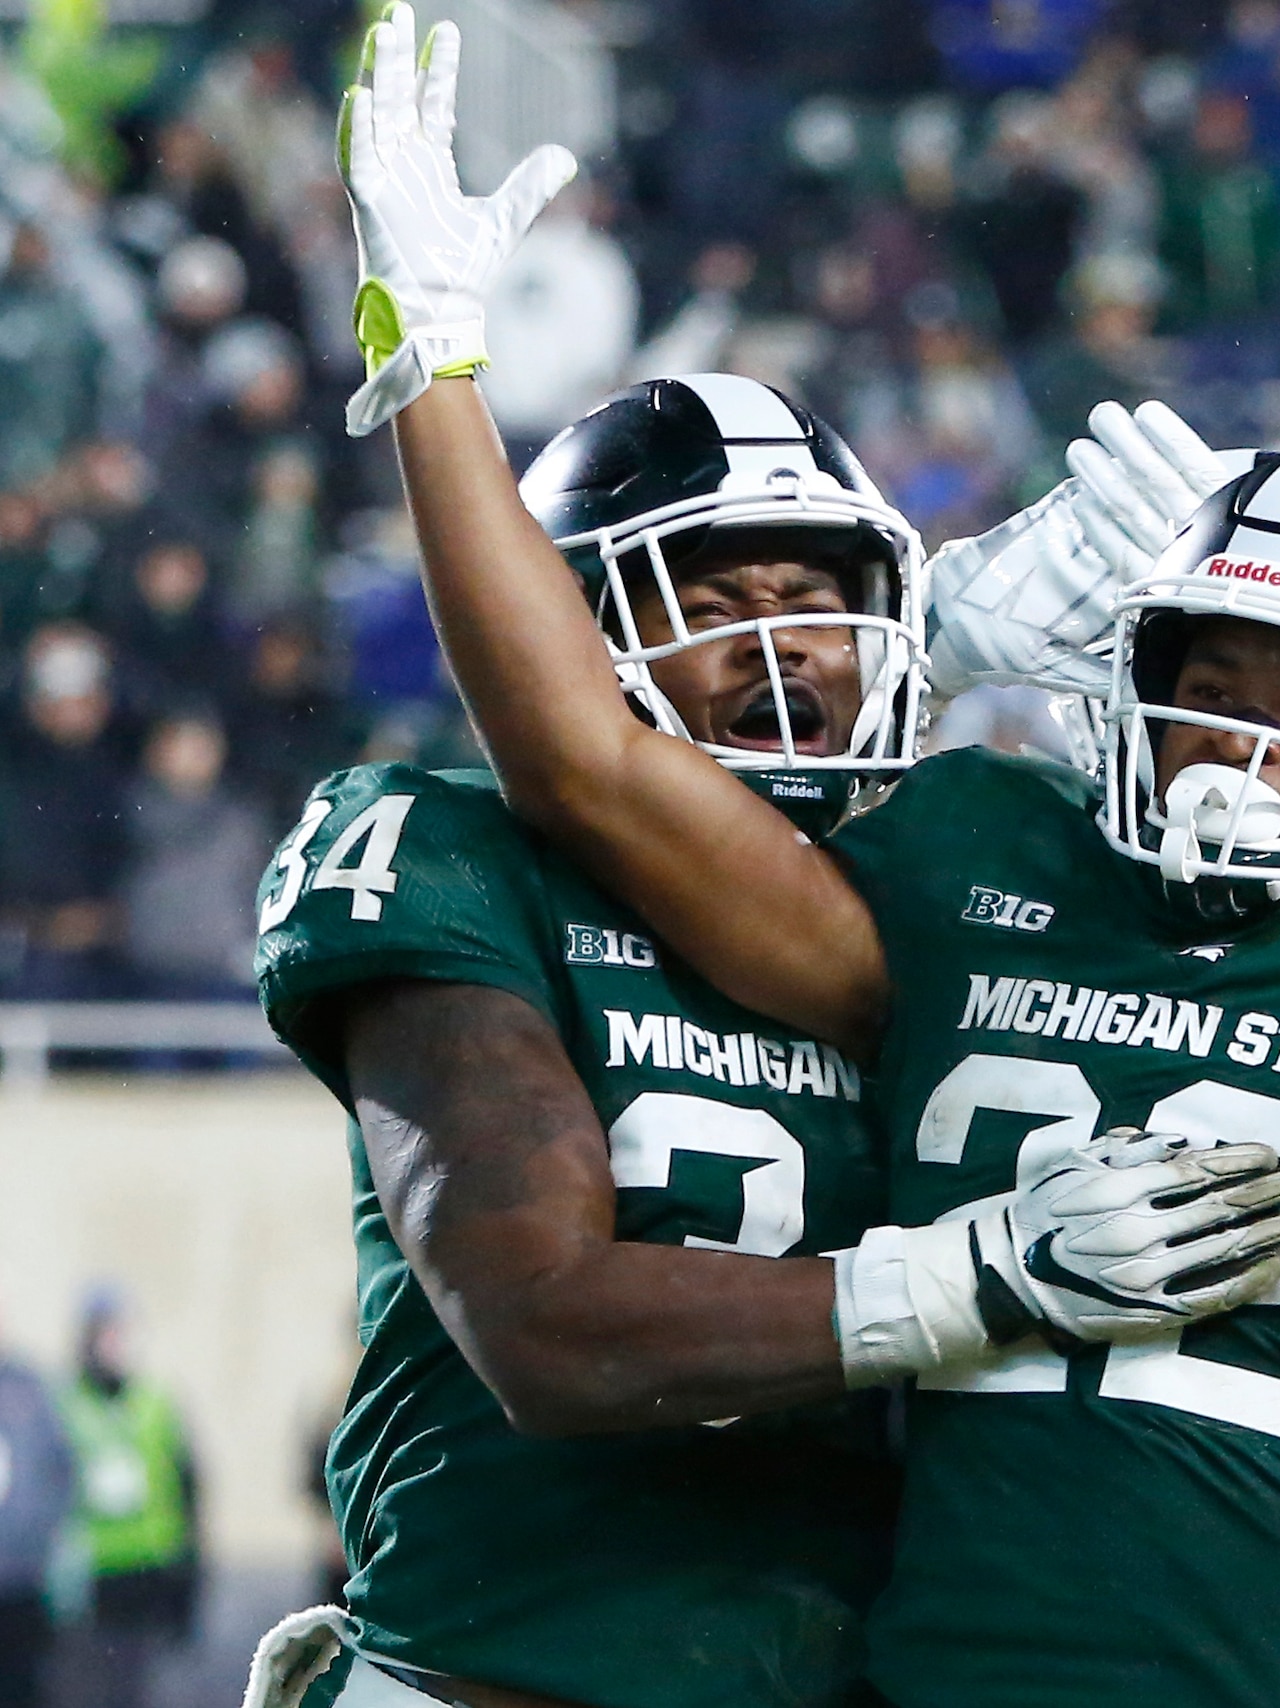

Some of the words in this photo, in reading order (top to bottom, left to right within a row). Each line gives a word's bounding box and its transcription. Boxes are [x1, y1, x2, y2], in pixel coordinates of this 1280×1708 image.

[772, 783, 825, 800] Riddell
[259, 794, 416, 935] 34
[603, 1009, 861, 1102] MICHIGAN
[957, 973, 1224, 1058] MICHIGAN
